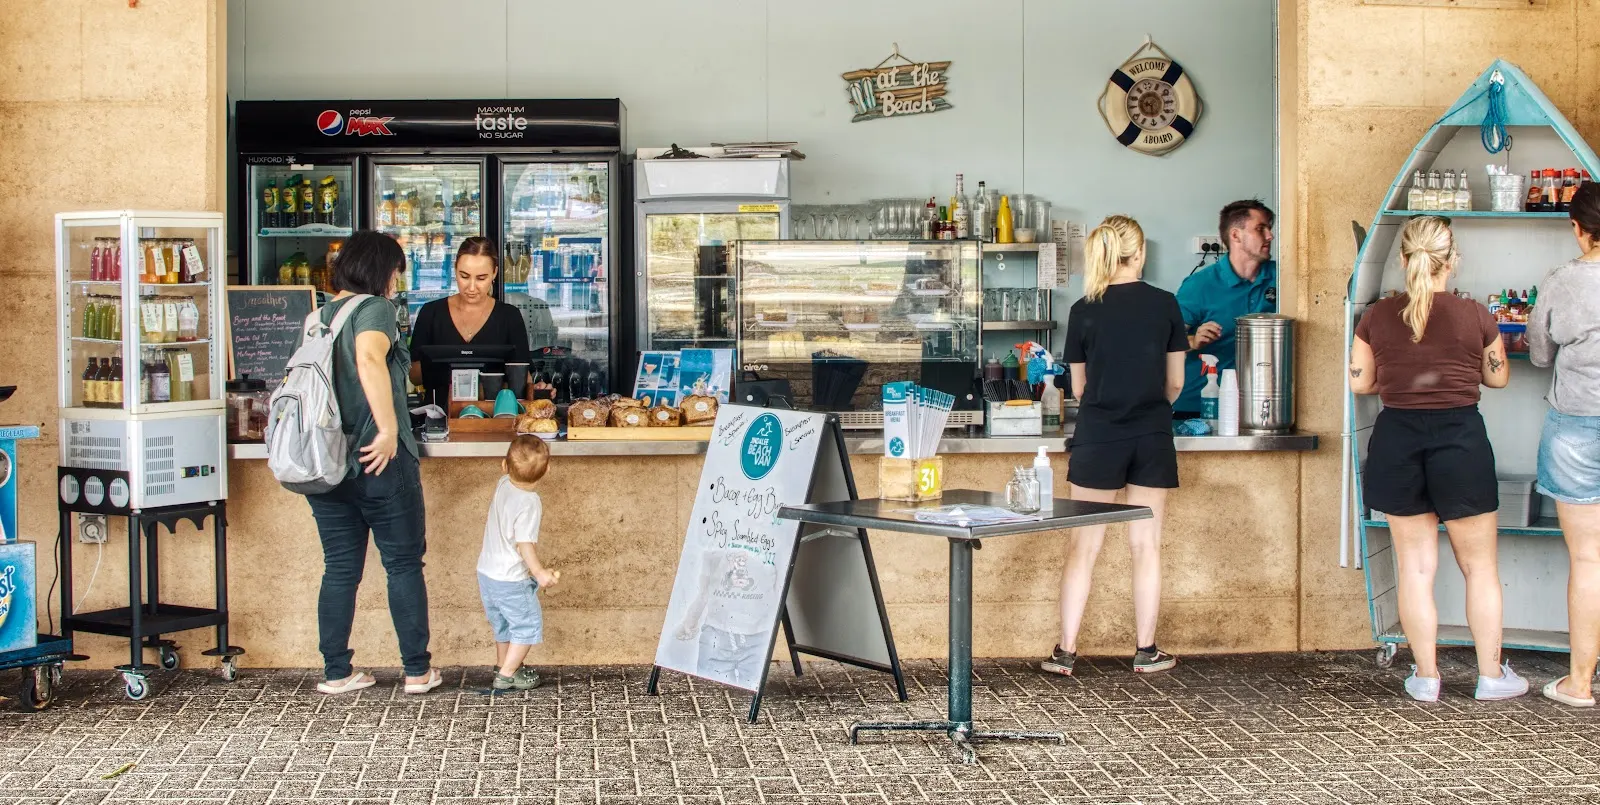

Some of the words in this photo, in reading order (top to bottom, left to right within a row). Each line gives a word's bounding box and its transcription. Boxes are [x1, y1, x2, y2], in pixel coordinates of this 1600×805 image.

[877, 66, 900, 89] at
[910, 62, 940, 86] the
[1129, 61, 1166, 76] WELCOME
[879, 87, 936, 116] Beach
[349, 108, 371, 116] pepsi
[345, 116, 396, 137] MAX
[474, 113, 528, 131] taste
[1143, 132, 1173, 144] ABOARD
[747, 444, 773, 456] BEACH
[754, 454, 771, 467] VAN
[920, 468, 935, 491] 31
